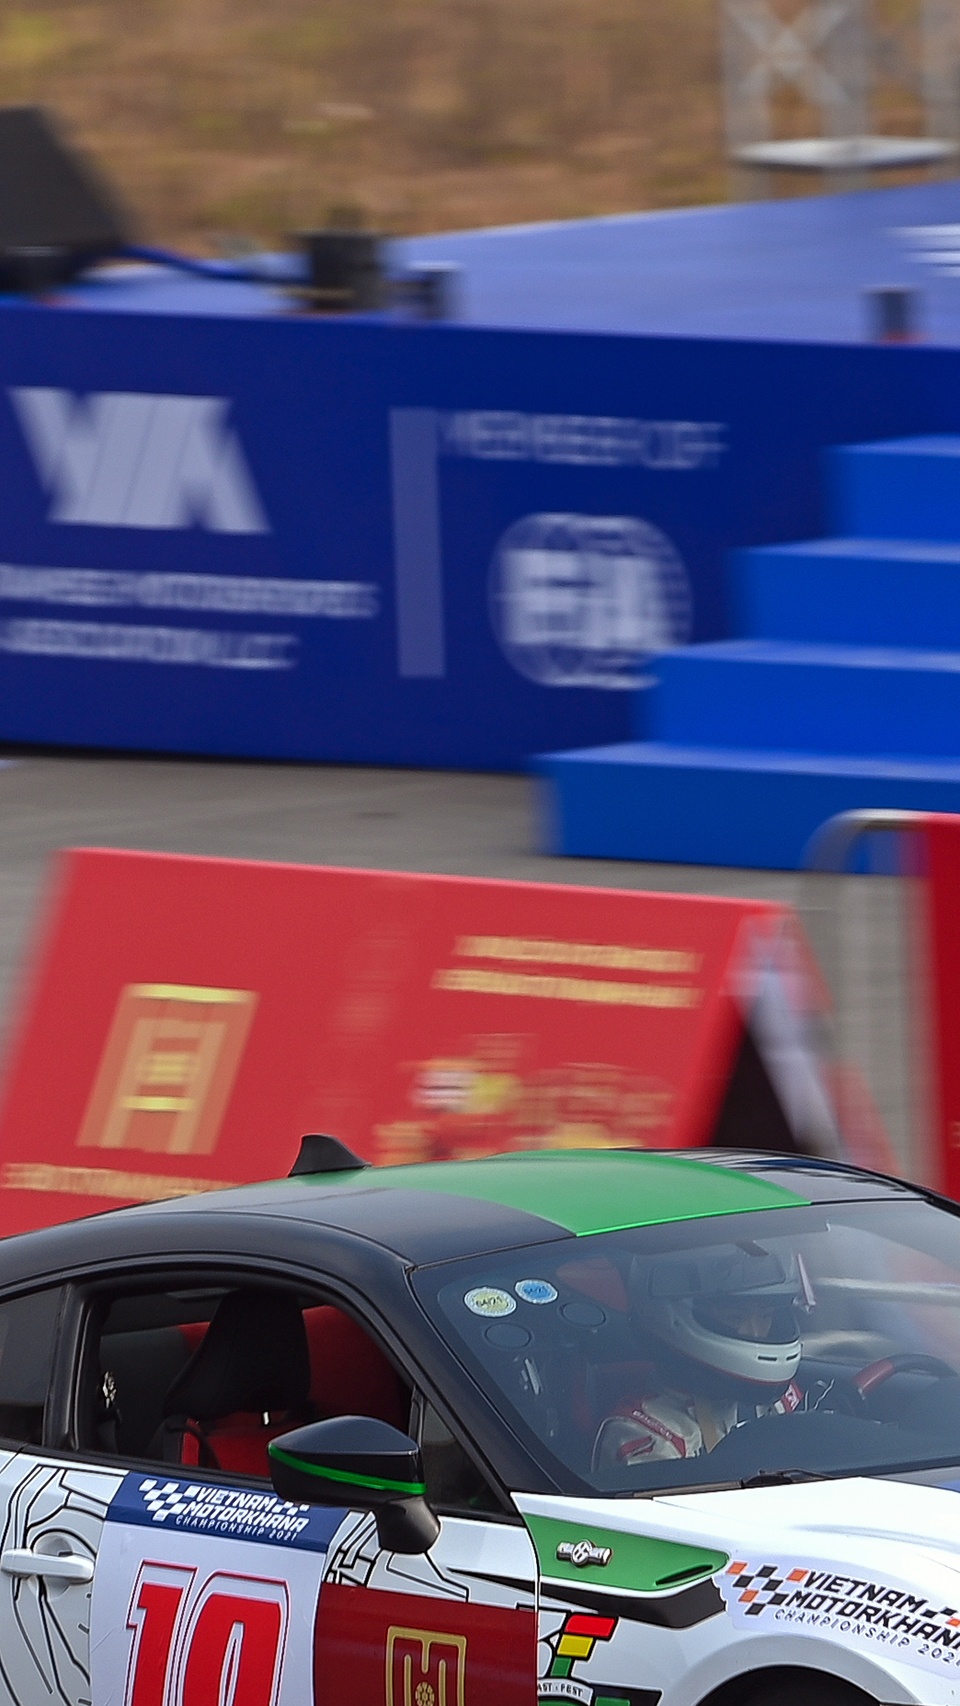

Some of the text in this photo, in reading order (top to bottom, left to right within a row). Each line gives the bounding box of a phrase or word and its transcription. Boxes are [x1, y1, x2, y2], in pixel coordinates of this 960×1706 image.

[195, 1486, 277, 1512] VIETNAM
[175, 1516, 299, 1541] CHAMPIONSHIP 2021
[181, 1502, 309, 1532] MOTORKHANA
[803, 1571, 930, 1614] VIETNAM
[774, 1608, 911, 1647] CHAMPIONSHIP
